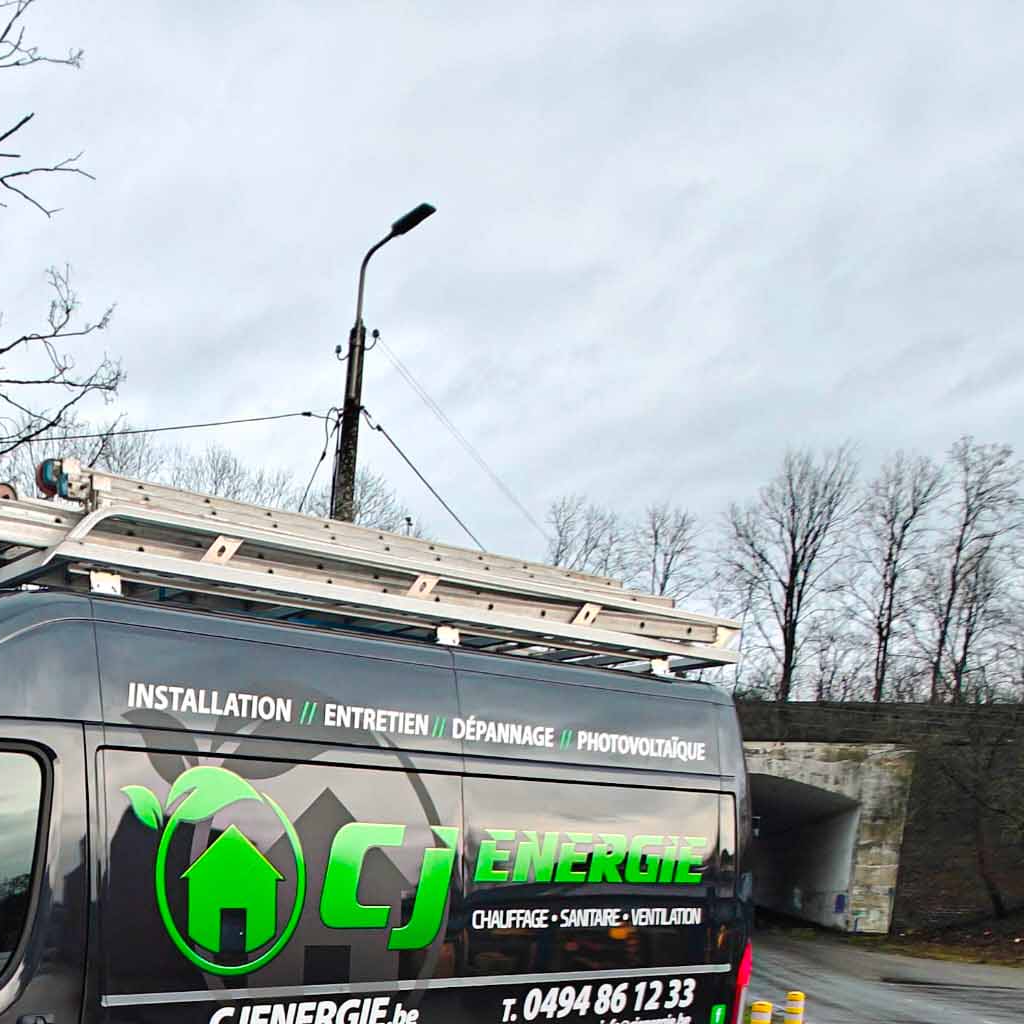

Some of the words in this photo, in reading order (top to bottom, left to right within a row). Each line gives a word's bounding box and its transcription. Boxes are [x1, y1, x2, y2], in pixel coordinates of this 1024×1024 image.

[127, 682, 292, 723] INSTALLATION
[323, 703, 429, 736] ENTRETIEN
[452, 715, 555, 748] DÉPANNAGE
[576, 730, 706, 762] PHOTOVOLTAÏQUE
[319, 821, 460, 952] CJ
[473, 828, 708, 885] ENERGIE
[472, 908, 550, 930] CHAUFFAGE
[559, 907, 622, 928] SANITAIRE
[631, 907, 702, 926] VENTILATION
[502, 998, 518, 1023] T.
[523, 984, 592, 1021] 0494
[593, 982, 628, 1015] 86
[633, 979, 664, 1012] 12
[664, 977, 697, 1010] 33
